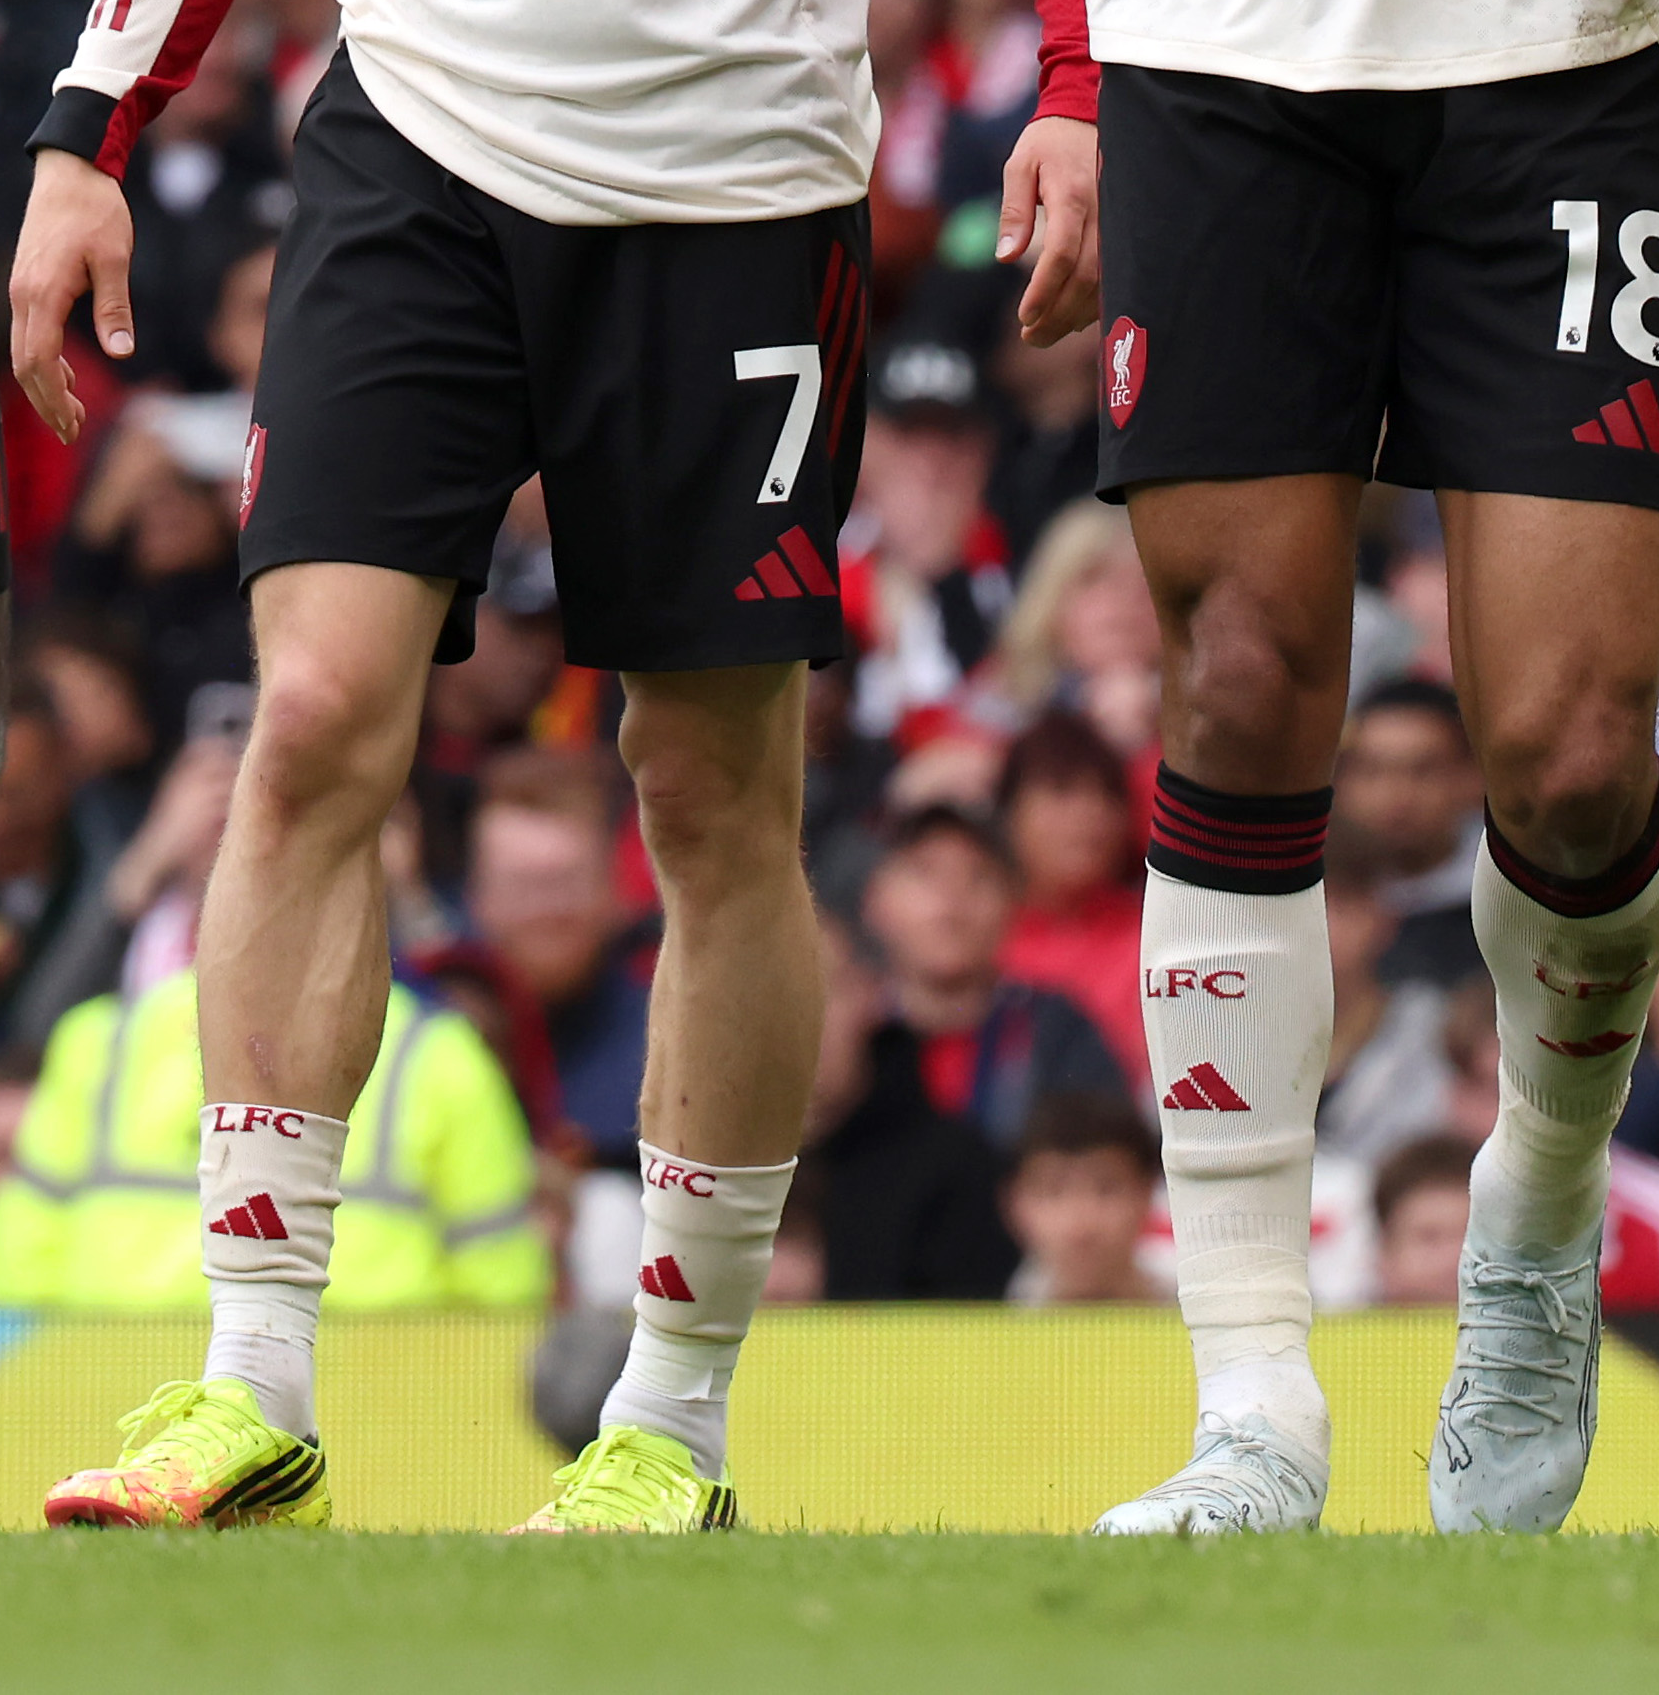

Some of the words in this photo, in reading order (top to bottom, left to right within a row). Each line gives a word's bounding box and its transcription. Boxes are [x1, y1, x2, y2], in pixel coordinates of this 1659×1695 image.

[733, 343, 824, 505] 7
[1145, 967, 1248, 1000] LFC
[214, 1105, 306, 1140] LFC
[646, 1158, 717, 1200] LFC
